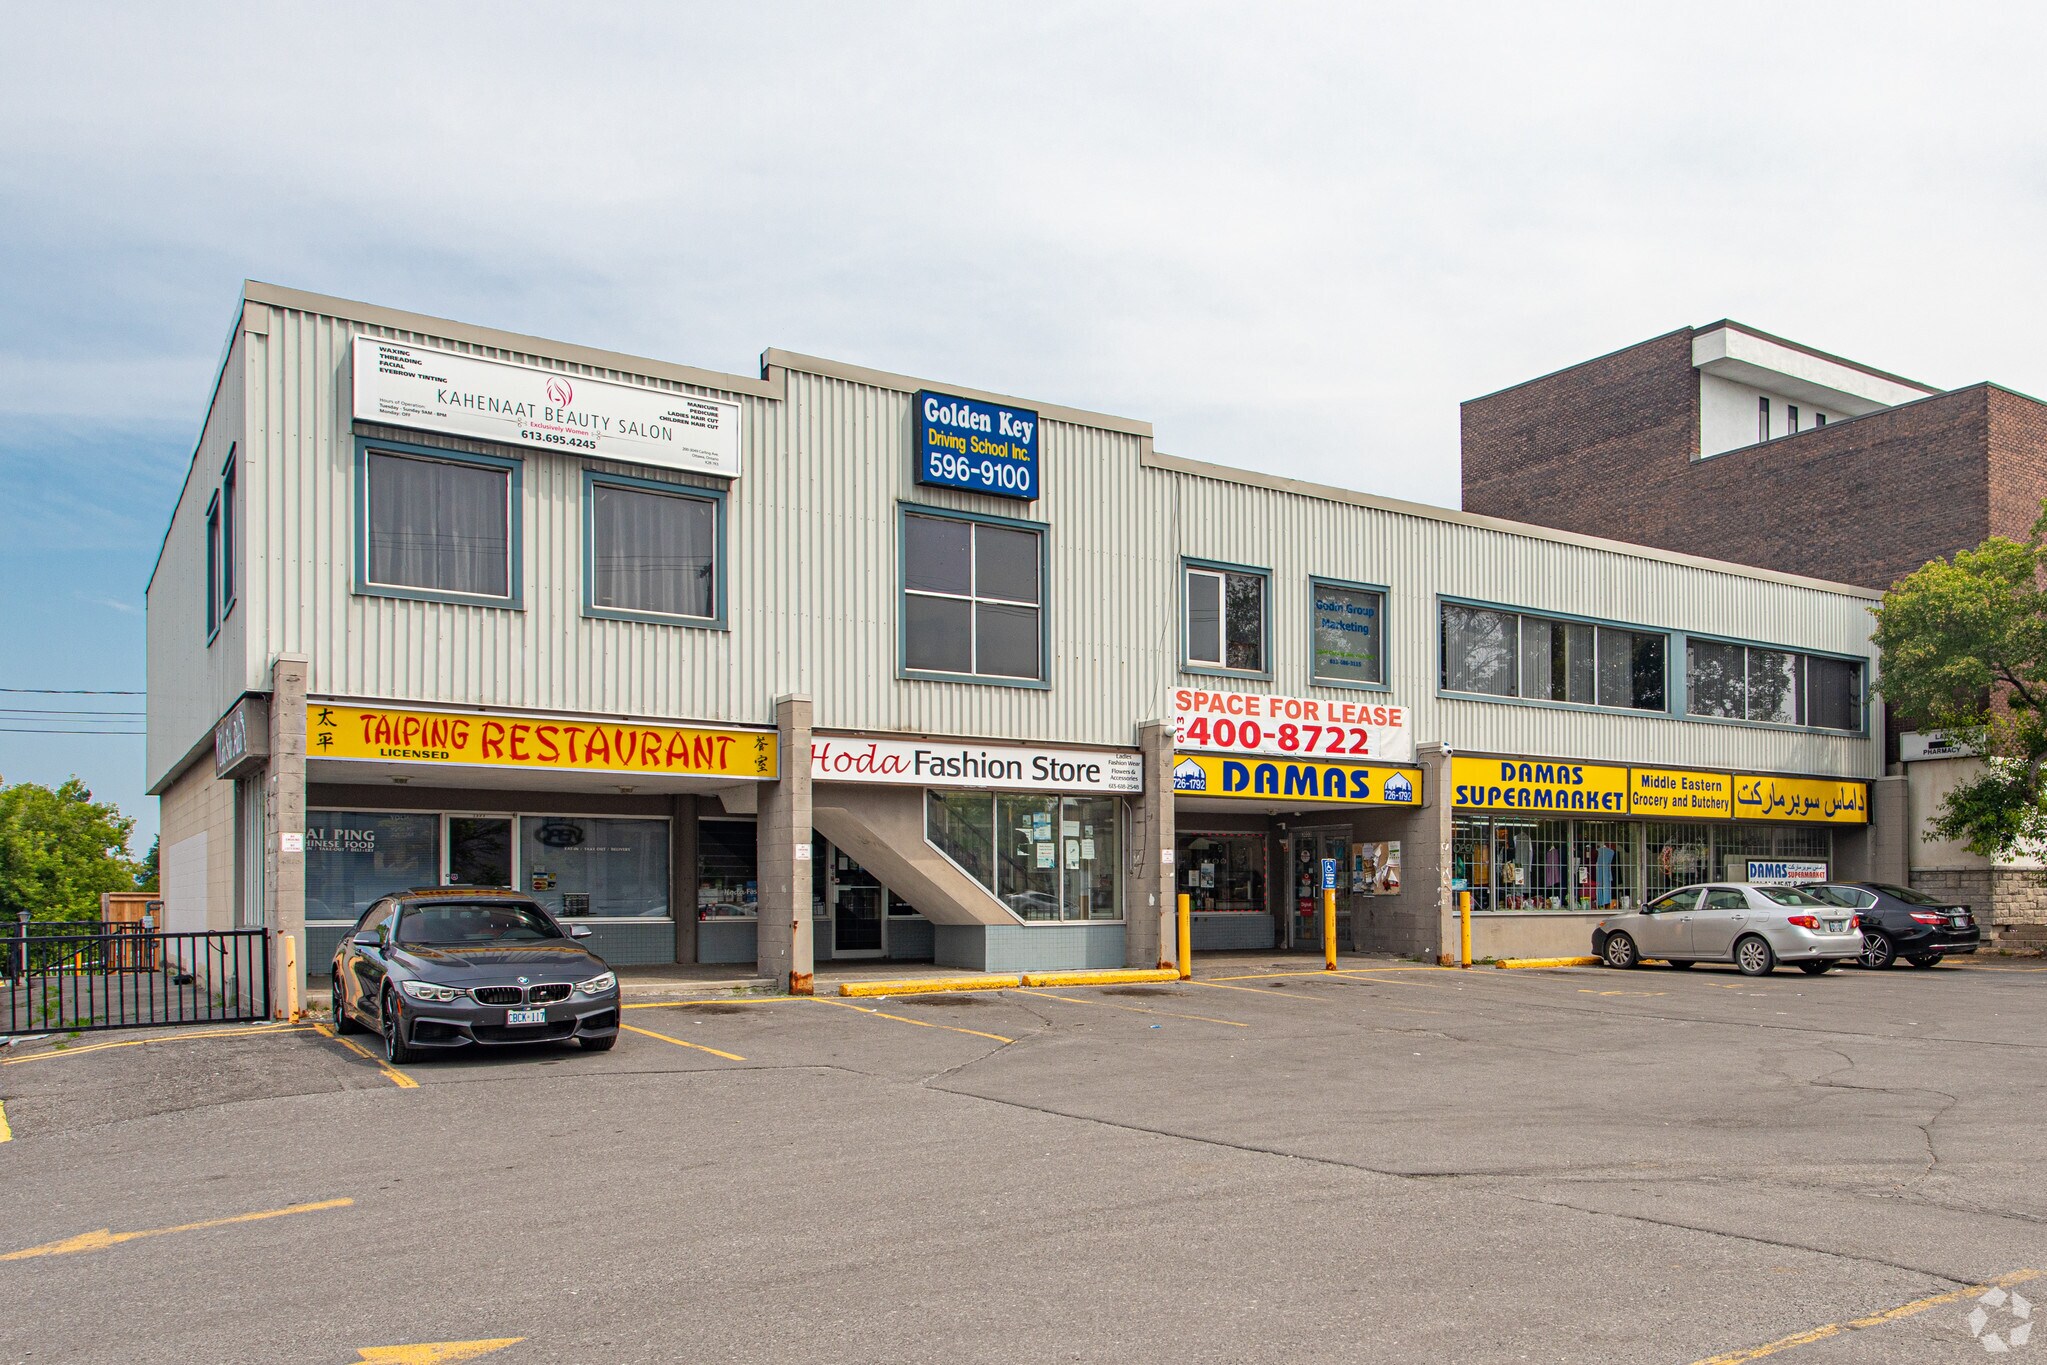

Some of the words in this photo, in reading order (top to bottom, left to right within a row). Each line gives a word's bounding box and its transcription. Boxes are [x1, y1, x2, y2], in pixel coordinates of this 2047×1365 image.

[379, 346, 410, 356] WAXING
[379, 353, 422, 365] THREADING
[379, 360, 405, 369] FACIAL
[379, 367, 415, 378] EYEBROW
[417, 373, 448, 383] TINTING
[380, 403, 399, 411] Tuesday
[403, 406, 420, 414] Sunday
[437, 388, 536, 418] KAHENAAT
[545, 406, 610, 431] BEAUTY
[619, 419, 672, 441] SALON
[687, 401, 719, 412] MANICURE
[689, 408, 719, 418] PEDICURE
[659, 415, 690, 425] CHILDREN
[690, 420, 706, 428] HAIR
[667, 410, 689, 419] LADIES
[690, 414, 706, 422] HAIR
[924, 397, 991, 433] Golden
[998, 411, 1034, 444] Key
[530, 421, 564, 433] Exclusively
[565, 427, 589, 436] Women
[521, 429, 597, 449] 613.695.4245
[928, 428, 966, 454] Driving
[970, 436, 1008, 458] School
[1011, 443, 1031, 461] Inc.
[929, 451, 1030, 491] 596-9100
[1346, 603, 1374, 618] Group
[1321, 617, 1369, 635] Marketing
[1176, 690, 1260, 716] SPACE
[1269, 698, 1319, 721] FOR
[1328, 703, 1402, 727] LEASE
[316, 707, 337, 753] 太平
[1177, 716, 1185, 744] 613
[1187, 717, 1369, 755] 400-8722
[360, 713, 471, 750] TAIPING
[481, 720, 737, 770] RESTAURANT
[380, 748, 450, 760] LICENSED
[1923, 747, 1961, 755] PHARMACY
[811, 742, 911, 775] Hoda
[914, 749, 1022, 780] Fashion
[1032, 755, 1101, 783] Store
[1223, 760, 1370, 799] DAMAS
[1501, 761, 1583, 785] DAMAS
[1173, 778, 1206, 790] 726-1792
[1641, 774, 1677, 790] Middle
[1681, 777, 1722, 792] Eastern
[1384, 789, 1412, 801] 726-1792
[1456, 785, 1624, 811] SUPERMARKET
[1632, 791, 1668, 809] Grocery
[1672, 793, 1688, 807] and
[1691, 795, 1729, 811] Butchery
[1824, 786, 1864, 817] داماس
[306, 829, 324, 839] AI
[334, 829, 375, 841] PING
[306, 840, 339, 848] HINESE
[345, 841, 375, 849] FOOD
[1453, 843, 1474, 854] OPEN
[1750, 863, 1787, 878] DAMAS
